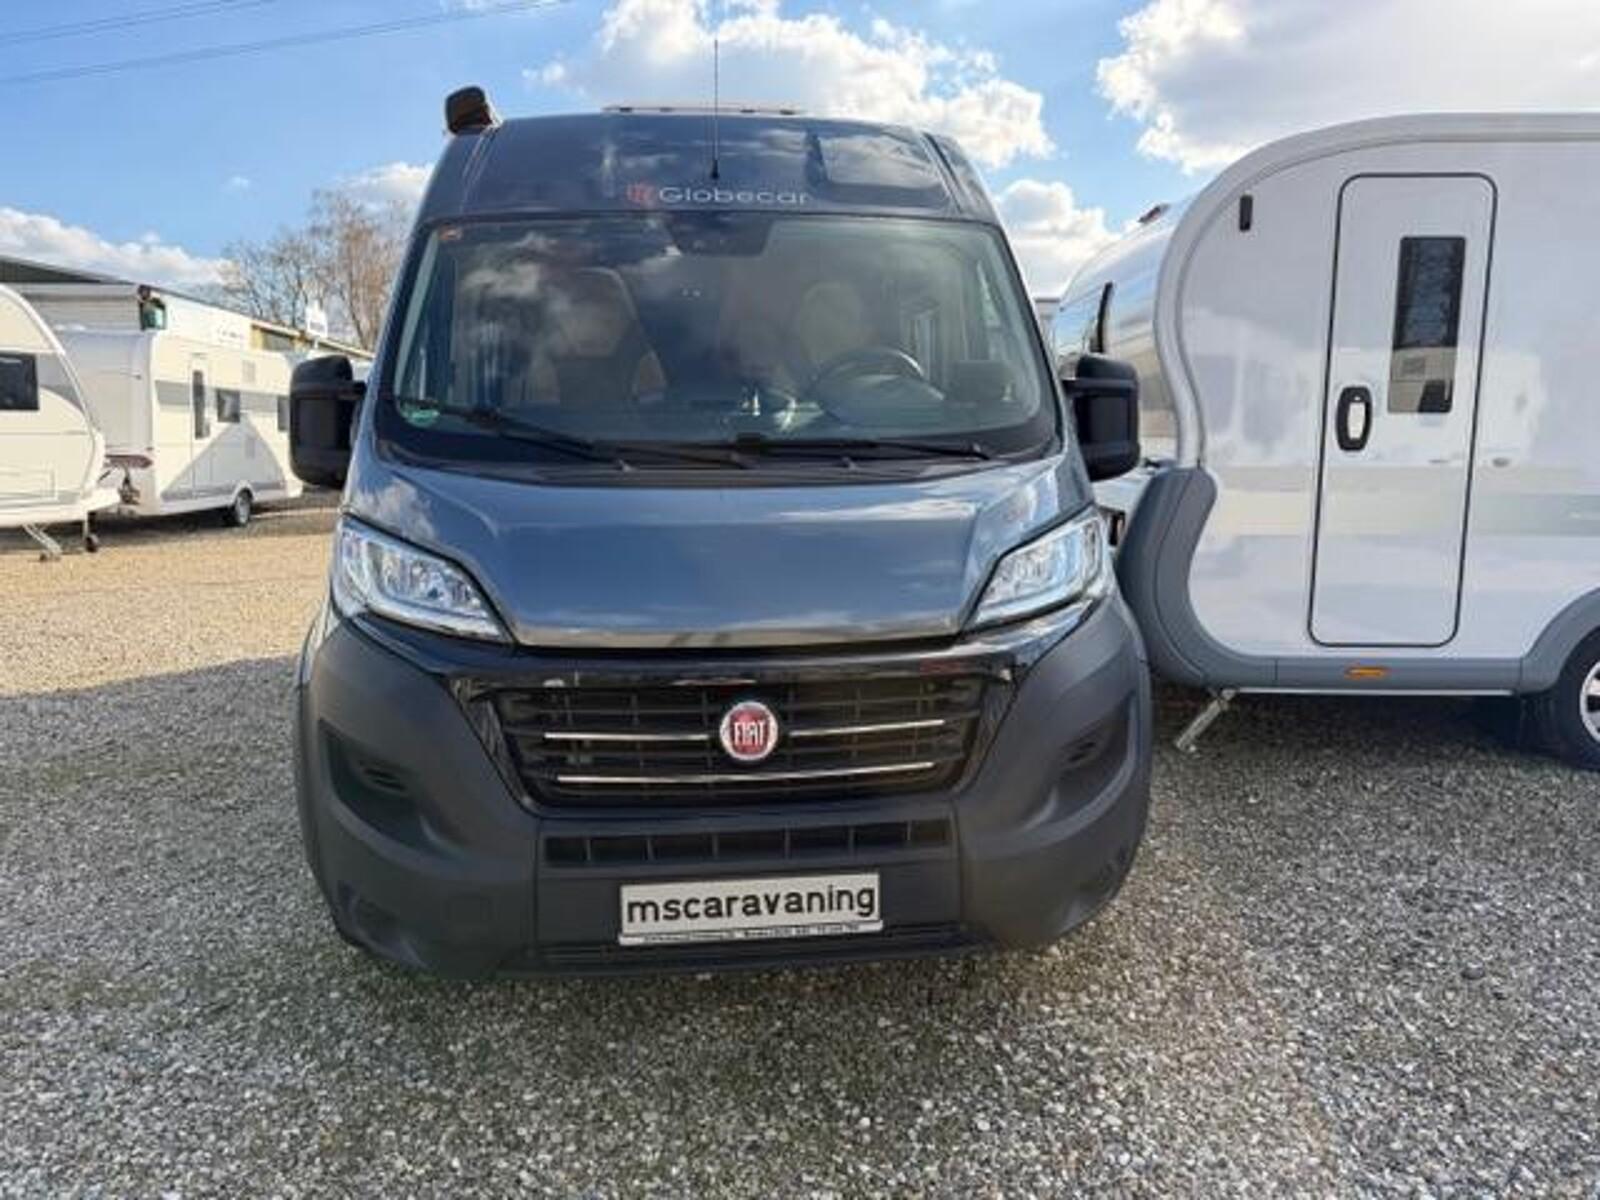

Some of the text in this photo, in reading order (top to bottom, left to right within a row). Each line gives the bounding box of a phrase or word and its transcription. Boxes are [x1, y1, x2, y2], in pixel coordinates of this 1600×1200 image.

[658, 186, 811, 204] Globecar
[733, 720, 765, 747] FIAT
[627, 884, 875, 922] mscaravaning
